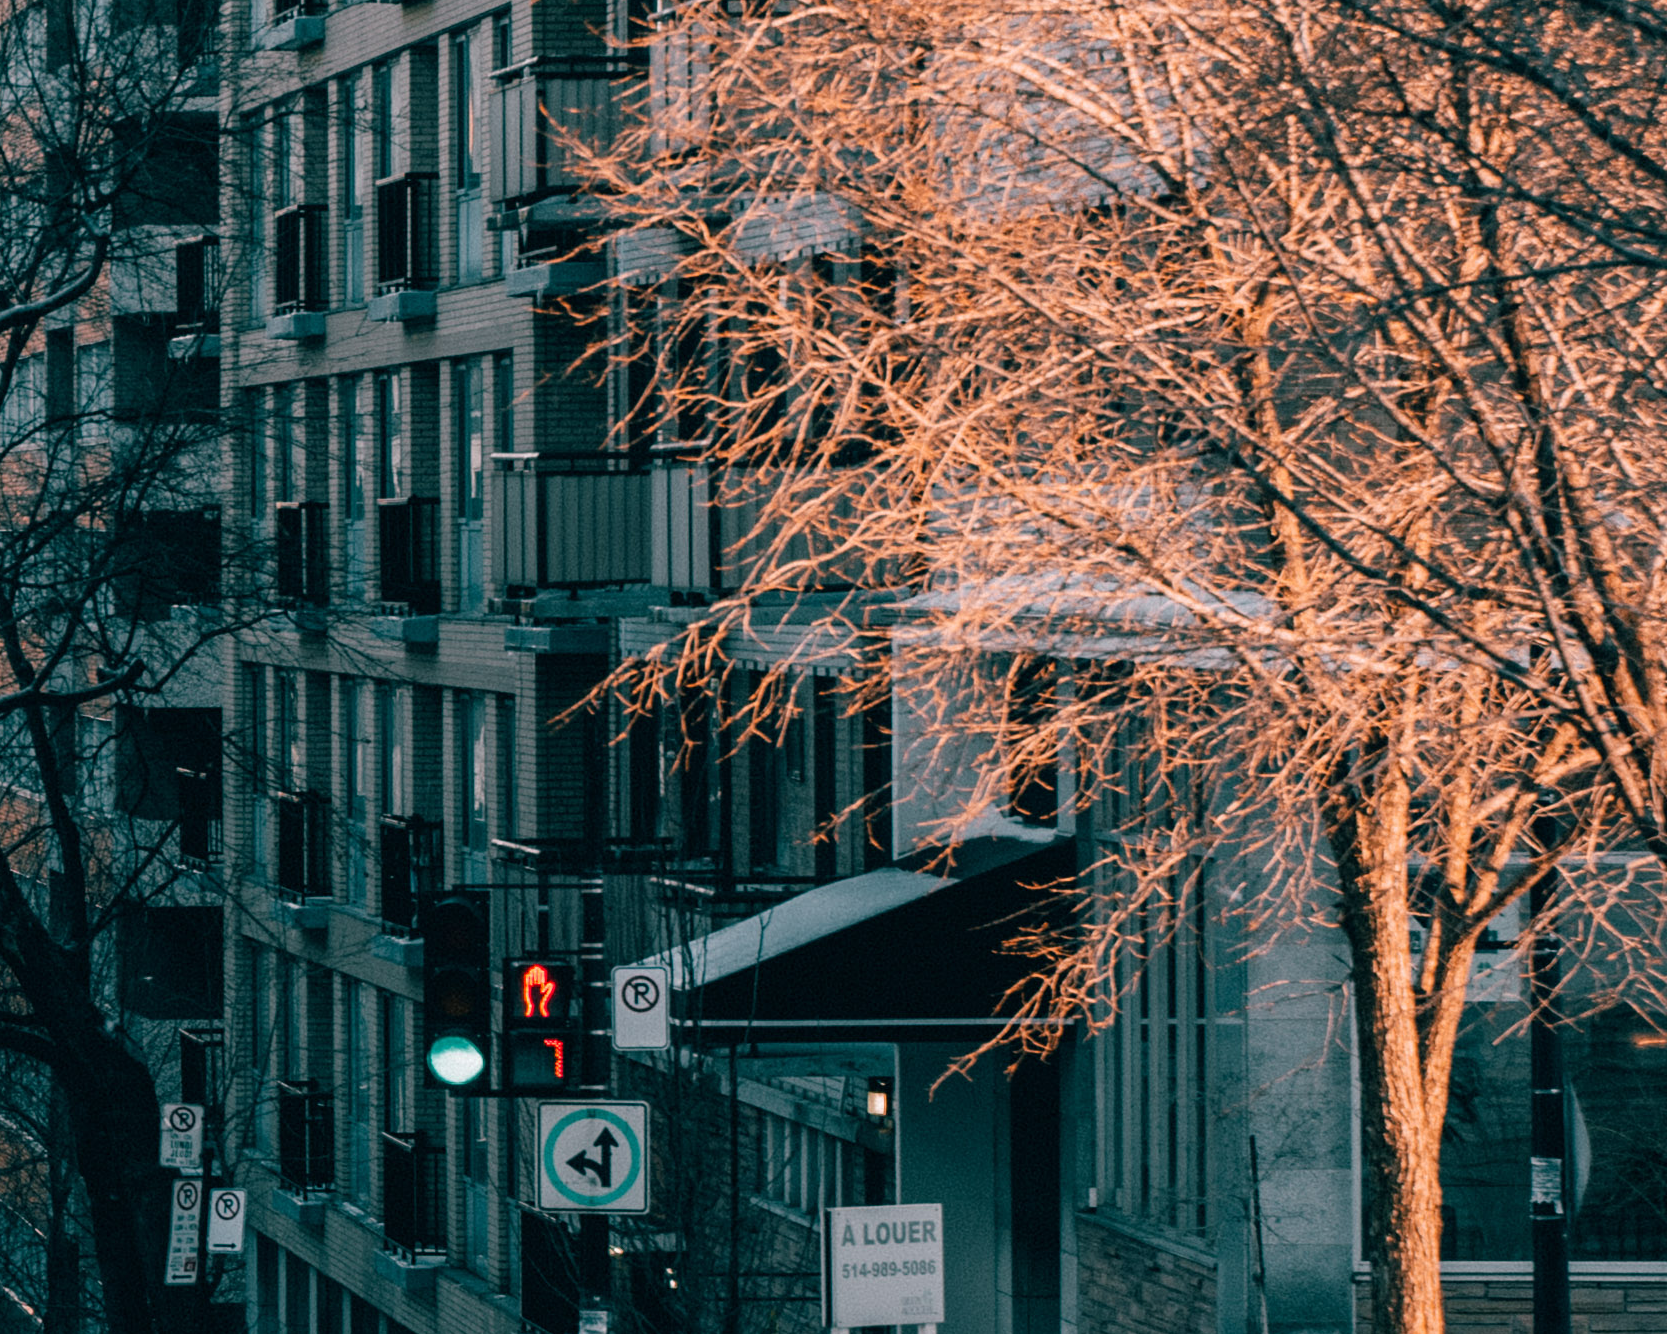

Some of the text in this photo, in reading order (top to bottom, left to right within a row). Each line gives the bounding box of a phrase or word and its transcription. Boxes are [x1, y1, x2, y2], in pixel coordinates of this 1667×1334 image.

[543, 1038, 564, 1079] 7
[863, 1220, 937, 1246] LOUER
[841, 1260, 937, 1279] 514-989-5086
